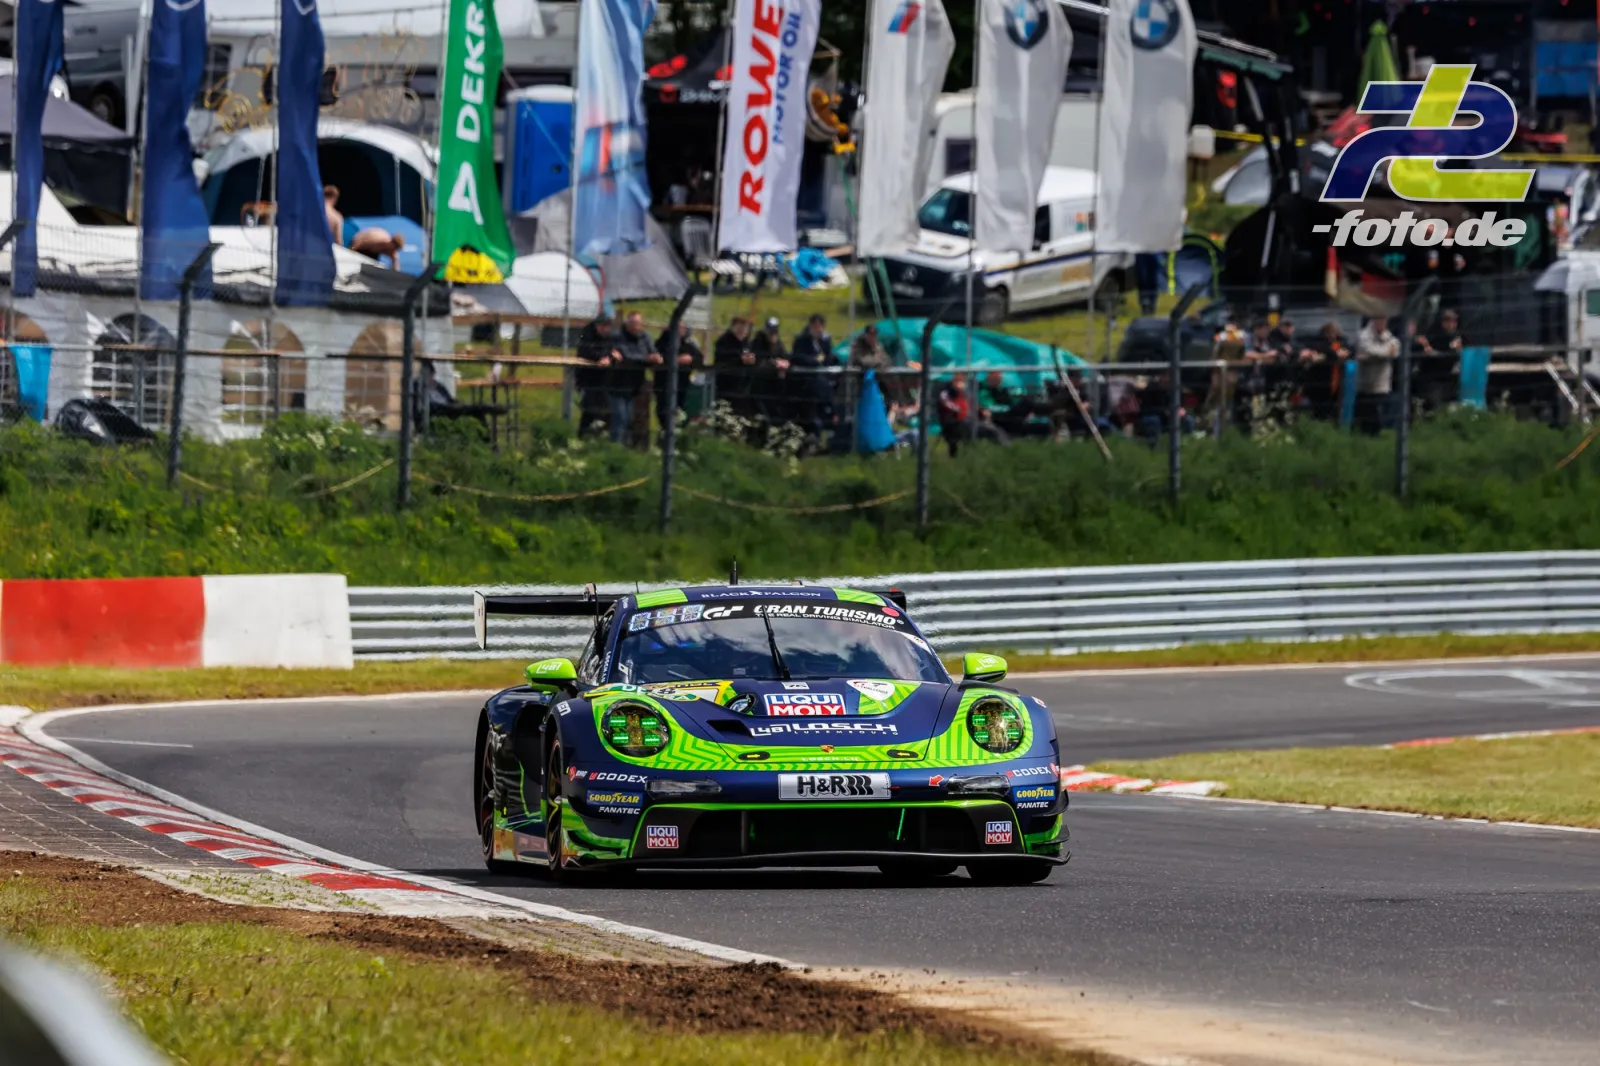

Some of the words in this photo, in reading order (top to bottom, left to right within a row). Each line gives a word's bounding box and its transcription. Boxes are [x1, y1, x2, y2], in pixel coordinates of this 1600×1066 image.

[456, 1, 485, 143] DEKR
[739, 0, 784, 215] ROWE
[754, 604, 808, 615] GRAN
[811, 606, 897, 625] TURISMO
[843, 616, 895, 630] SIMULATOR
[771, 694, 838, 704] LIQUI
[771, 705, 843, 716] MOLY
[792, 723, 898, 732] LOSCH
[1011, 766, 1052, 777] CODEX
[597, 772, 648, 783] CODEX
[1017, 801, 1049, 809] FANATEC
[599, 806, 640, 815] FANATEC
[648, 827, 676, 837] LIQUI
[988, 823, 1011, 833] LIQUI
[649, 837, 677, 847] MOLY
[988, 833, 1011, 843] MOLY
